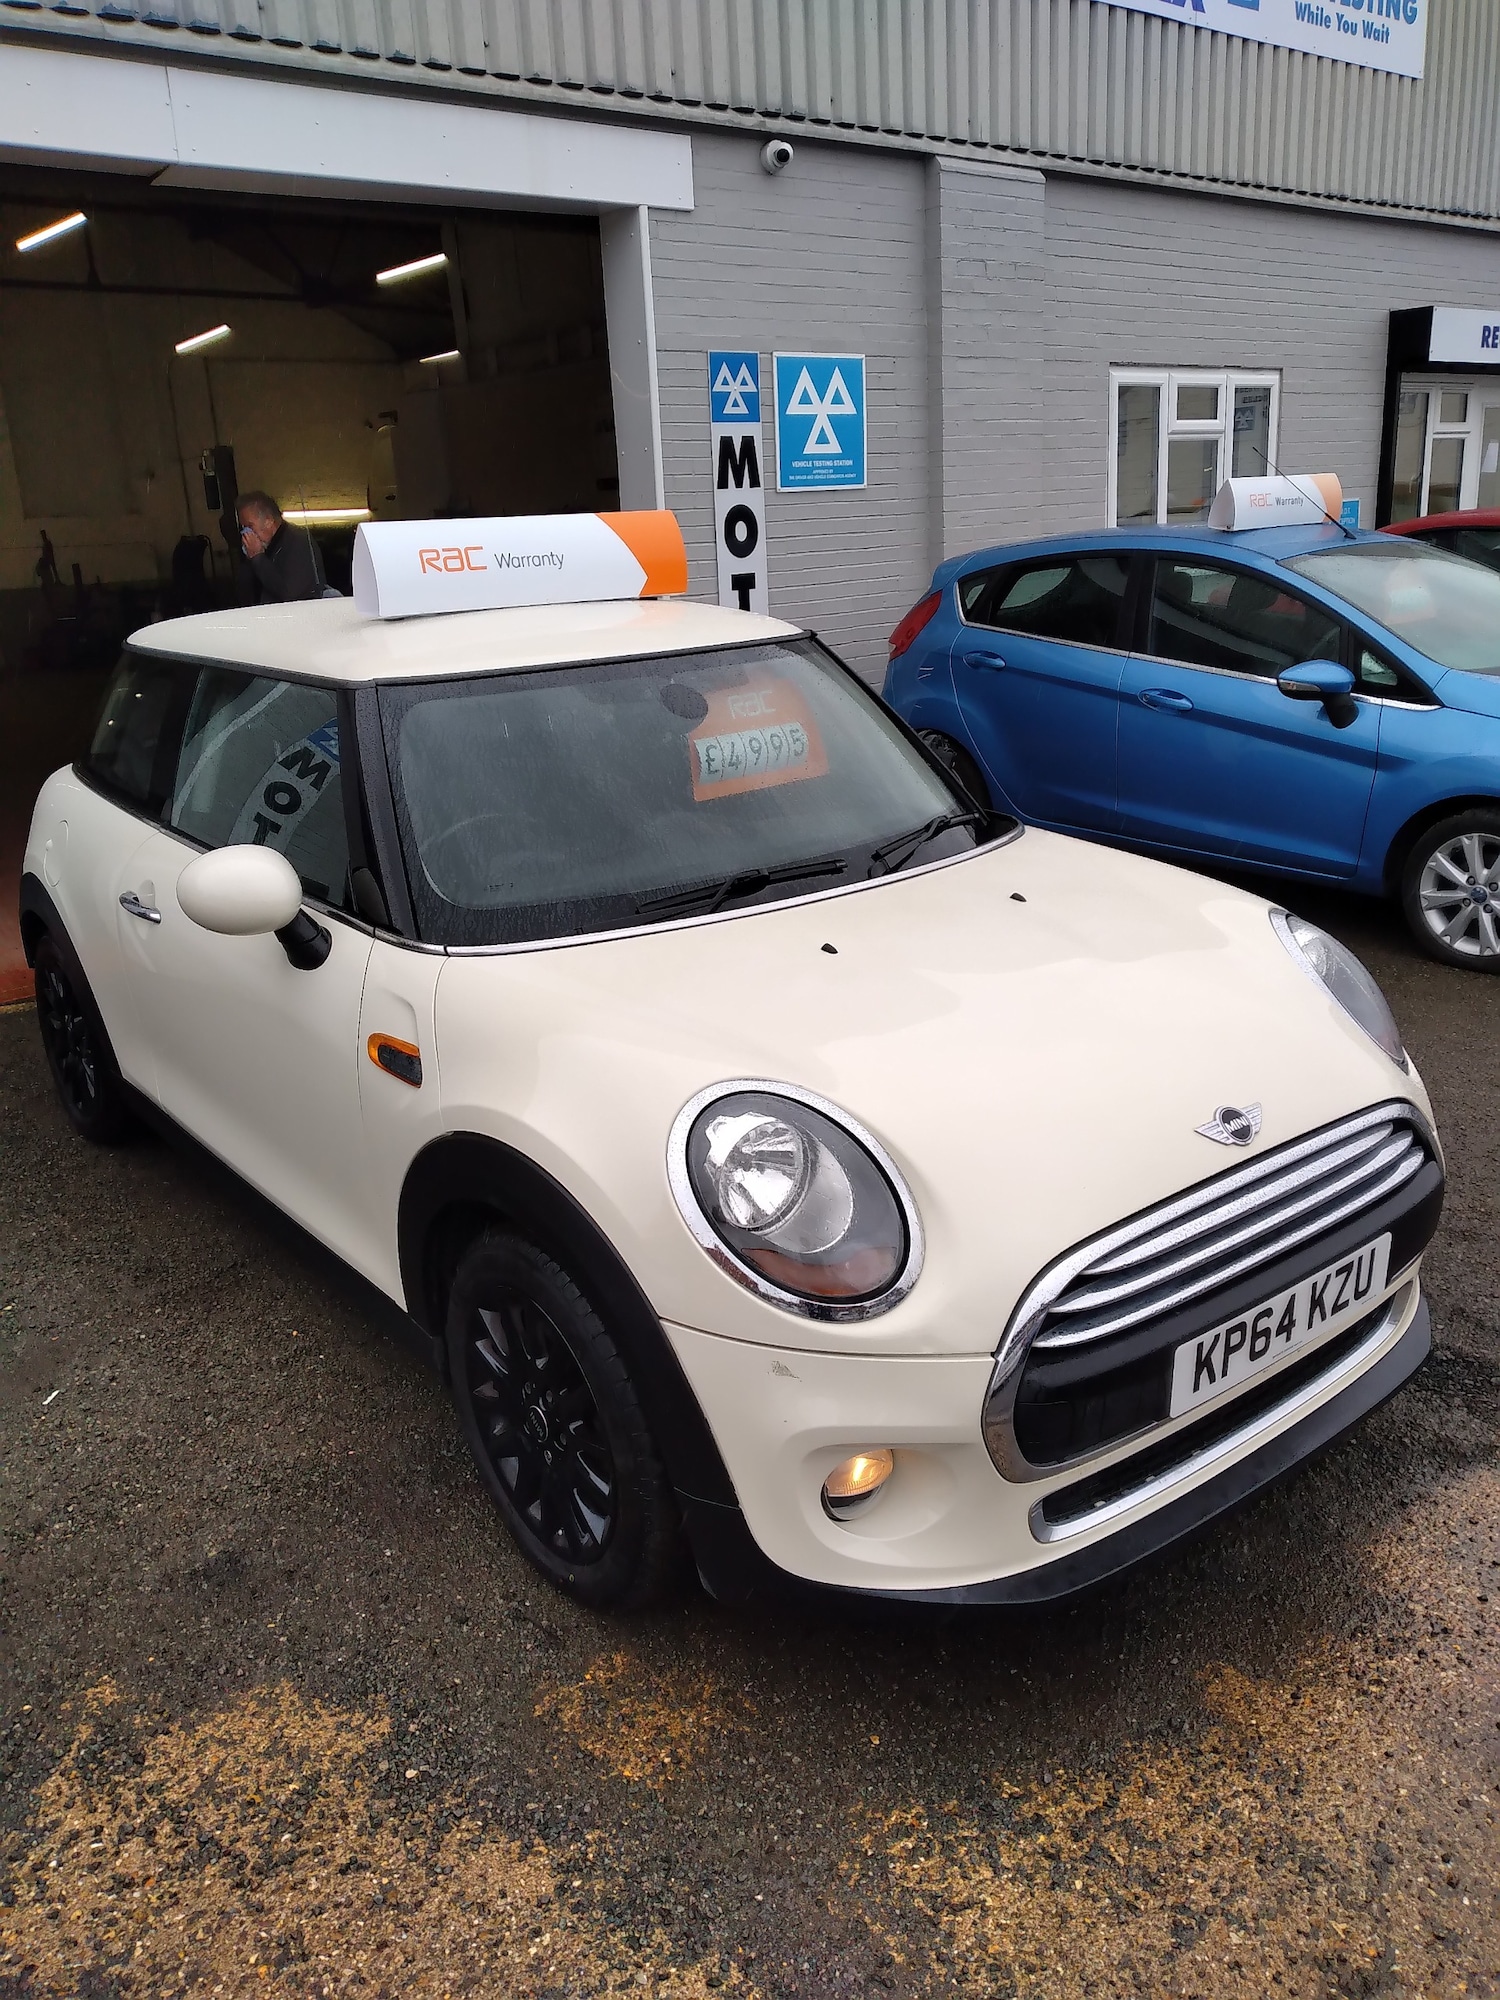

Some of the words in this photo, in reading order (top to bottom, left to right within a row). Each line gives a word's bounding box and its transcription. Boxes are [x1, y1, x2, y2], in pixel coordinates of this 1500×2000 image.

[1295, 1, 1332, 29] While
[1336, 12, 1358, 36] You
[1362, 19, 1390, 44] Wait
[1275, 495, 1304, 508] Warranty
[717, 435, 761, 612] MOT
[494, 551, 564, 570] Warranty
[705, 728, 805, 775] £4995
[1224, 1115, 1249, 1133] MINI
[1192, 1292, 1297, 1394] KP64
[1306, 1248, 1377, 1331] KZU
